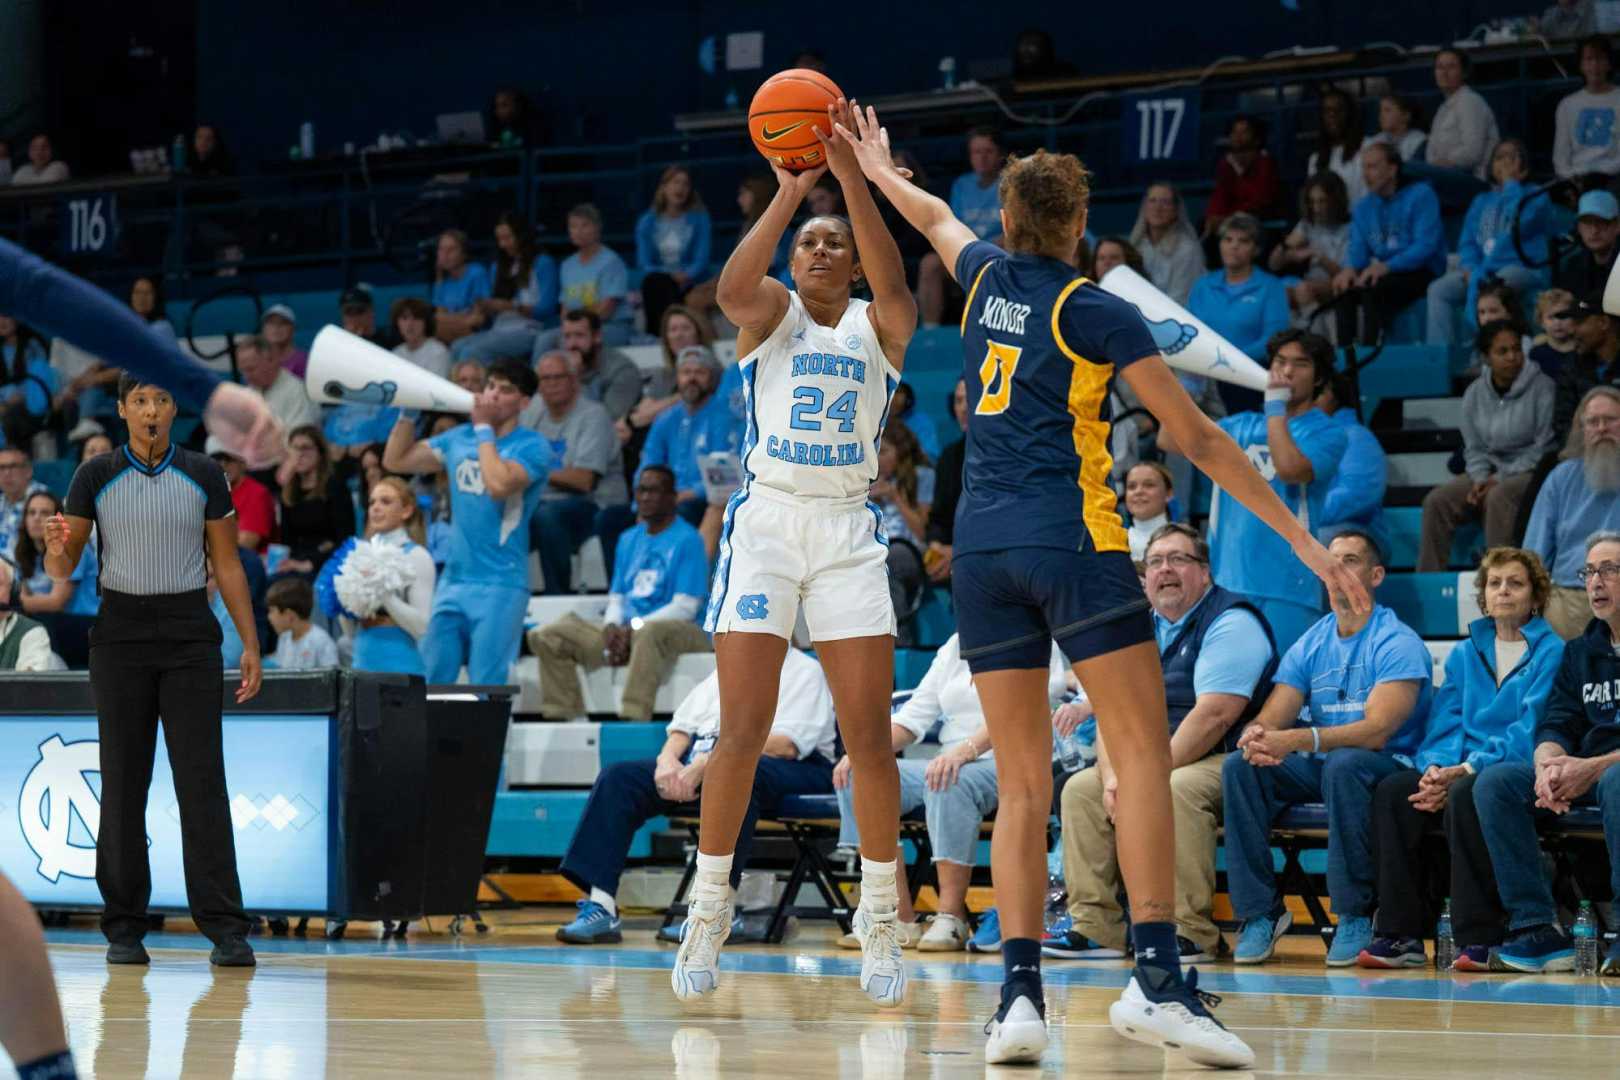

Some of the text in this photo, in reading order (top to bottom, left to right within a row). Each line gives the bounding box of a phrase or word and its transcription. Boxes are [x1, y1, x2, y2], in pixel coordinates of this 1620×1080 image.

[1136, 99, 1185, 160] 117
[69, 197, 106, 251] 116
[978, 295, 1031, 335] MINOR
[791, 352, 866, 384] NORTH
[974, 339, 1023, 415] 0
[789, 386, 857, 433] 24
